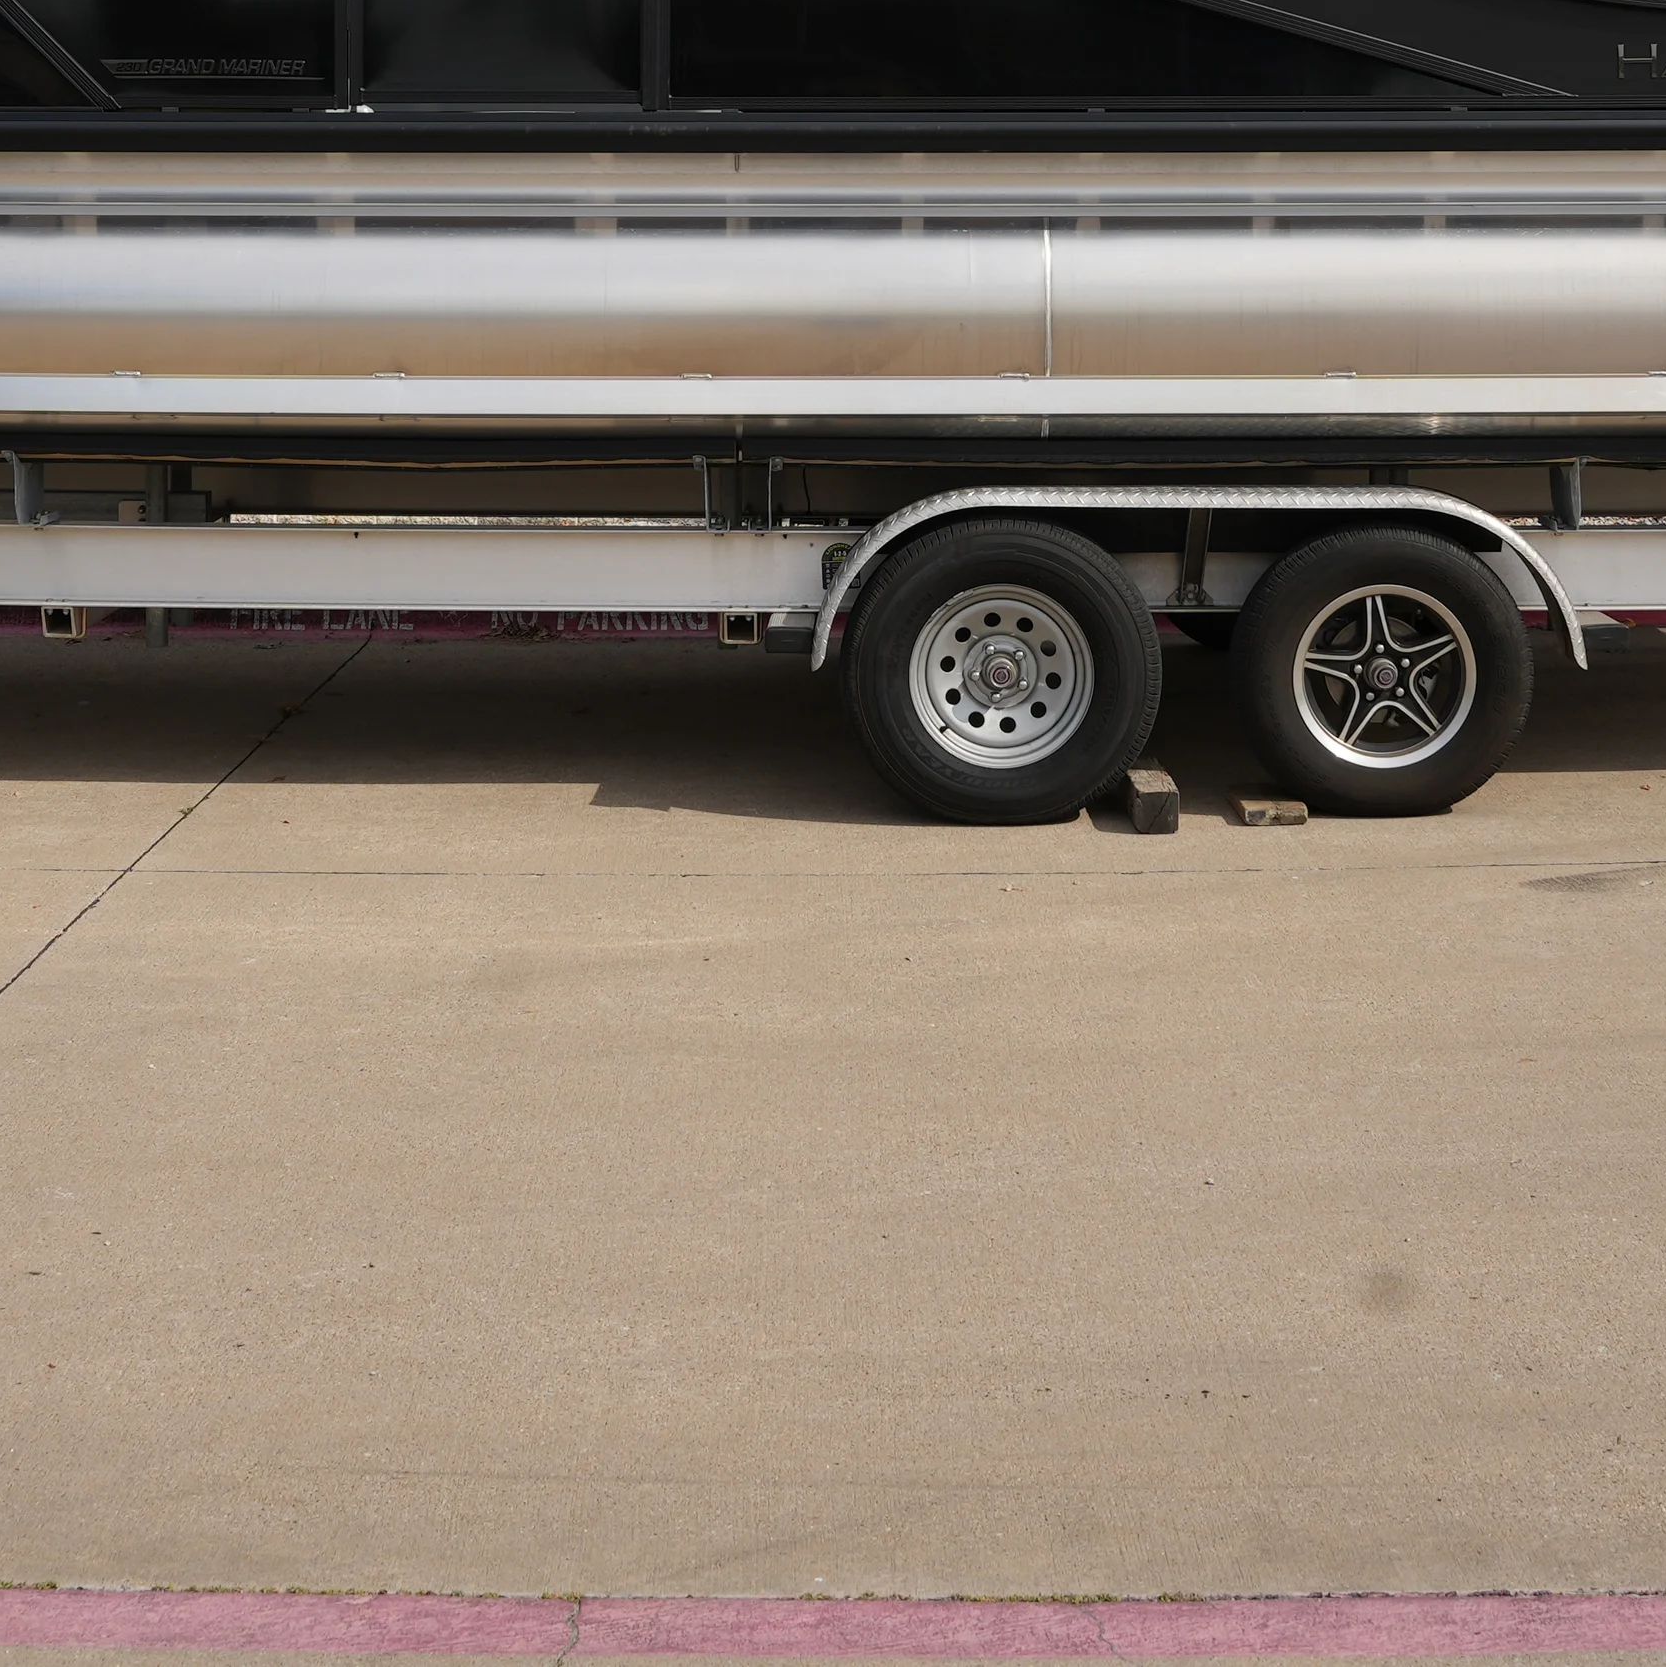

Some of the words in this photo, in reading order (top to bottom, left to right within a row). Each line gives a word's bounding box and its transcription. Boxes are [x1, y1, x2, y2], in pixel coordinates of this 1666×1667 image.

[115, 61, 142, 73] 230
[149, 58, 215, 75] GRAND
[218, 58, 306, 76] MARINER
